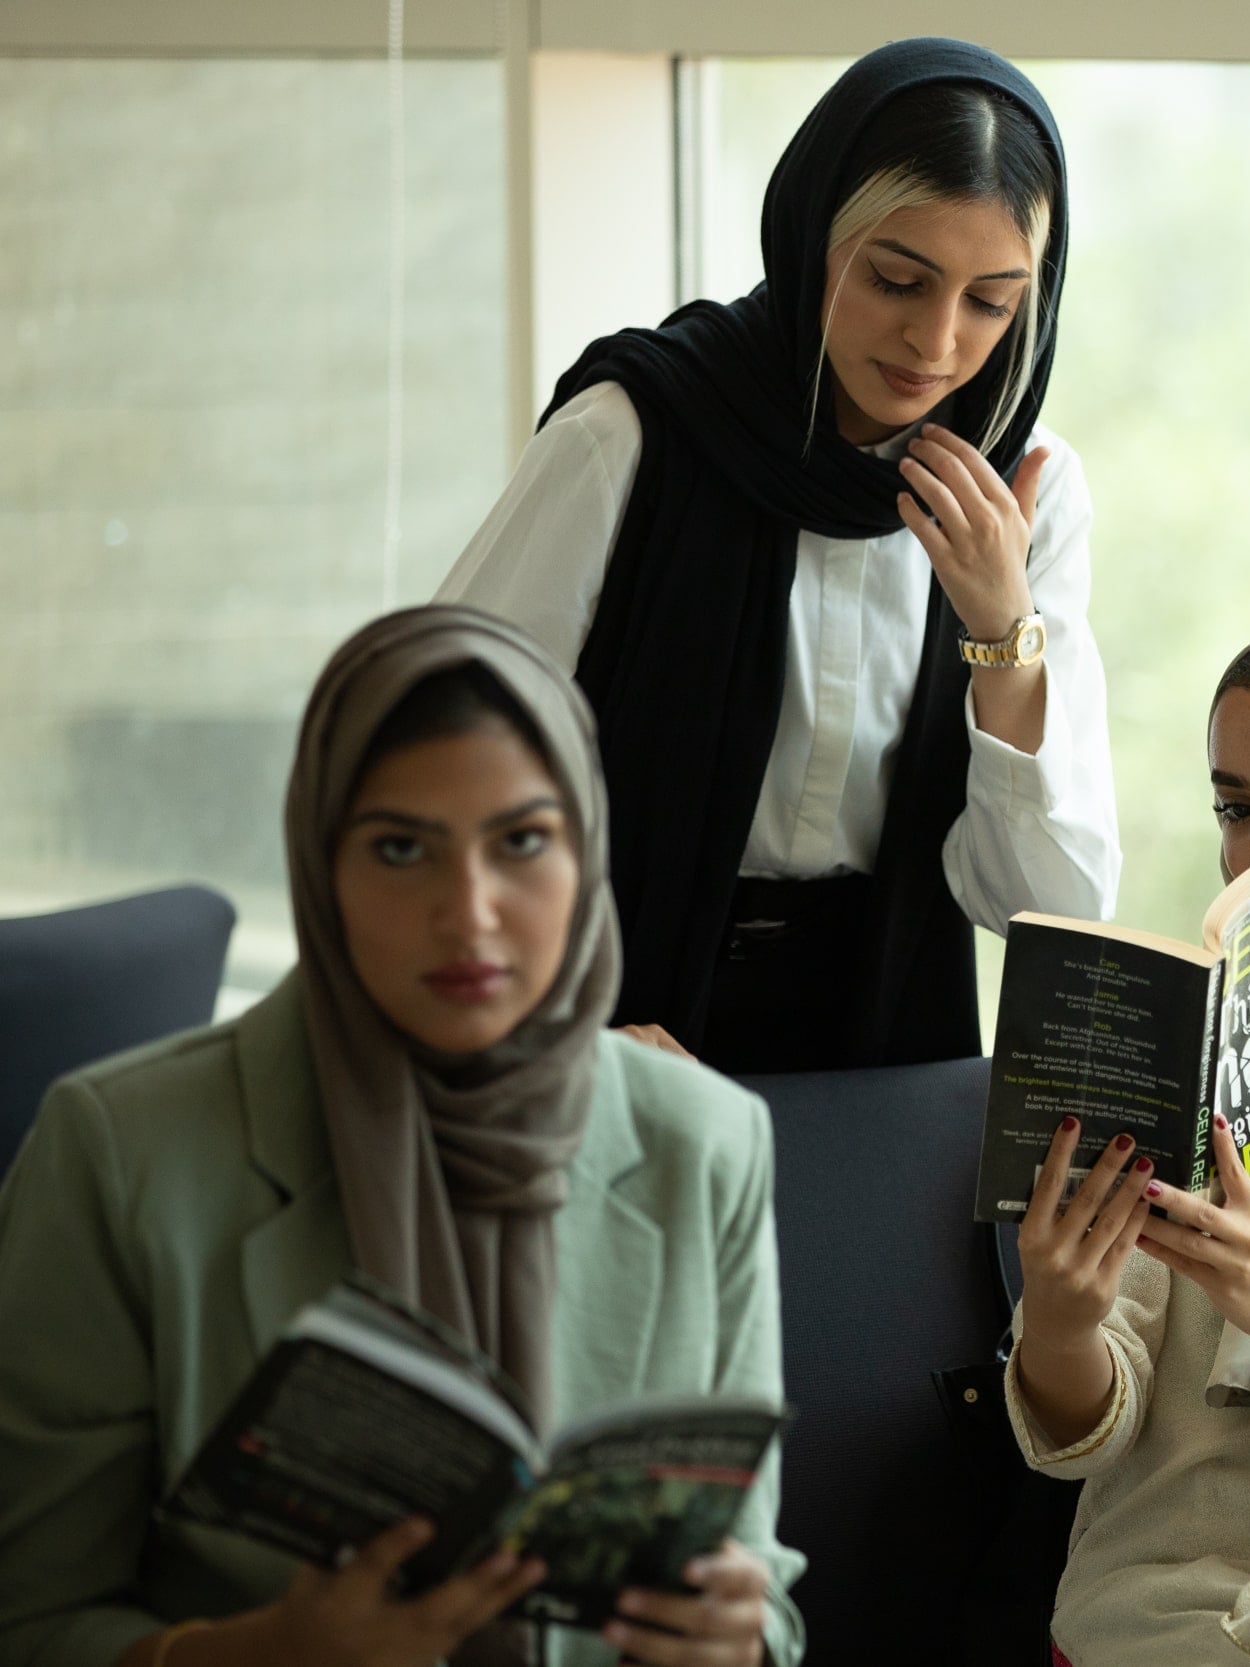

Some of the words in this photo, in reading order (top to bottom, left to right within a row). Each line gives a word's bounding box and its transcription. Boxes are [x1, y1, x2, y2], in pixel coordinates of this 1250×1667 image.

[1064, 960, 1083, 970] She's
[1099, 958, 1120, 970] Caro
[1067, 1001, 1086, 1011] Can't
[1113, 1008, 1126, 1018] she
[1042, 1022, 1060, 1031] Back
[1060, 1024, 1078, 1033] from
[1093, 1020, 1112, 1032] Rob
[1044, 1038, 1069, 1048] Except
[1069, 1041, 1086, 1050] with
[1106, 1048, 1116, 1056] He
[1096, 1038, 1109, 1047] Out
[1110, 1041, 1118, 1049] of
[1011, 1051, 1029, 1060] Over
[1030, 1053, 1042, 1061] the
[1043, 1056, 1068, 1064] course
[1069, 1057, 1078, 1065] of
[1078, 1060, 1092, 1068] one
[1124, 1068, 1140, 1077] their
[1141, 1072, 1157, 1082] lives
[1033, 1062, 1048, 1070] and
[1049, 1065, 1077, 1073] entwine
[1078, 1068, 1094, 1076] with
[1094, 1070, 1132, 1083] dangerous
[1003, 1074, 1017, 1082] The
[1018, 1076, 1050, 1086] brightest
[1051, 1079, 1075, 1088] flames
[1075, 1083, 1101, 1093] always
[1101, 1087, 1121, 1095] leave
[1121, 1090, 1133, 1098] the
[1134, 1093, 1162, 1105] deepest
[1024, 1102, 1043, 1110] book
[1044, 1104, 1054, 1112] by
[1055, 1105, 1093, 1116] bestselling
[1094, 1111, 1117, 1120] author
[1118, 1114, 1137, 1123] Celia
[1063, 1098, 1109, 1110] controversial
[1109, 1104, 1124, 1112] and
[1124, 1107, 1159, 1121] unsettling
[1194, 1106, 1210, 1158] CELIA
[1191, 1159, 1205, 1193] REE
